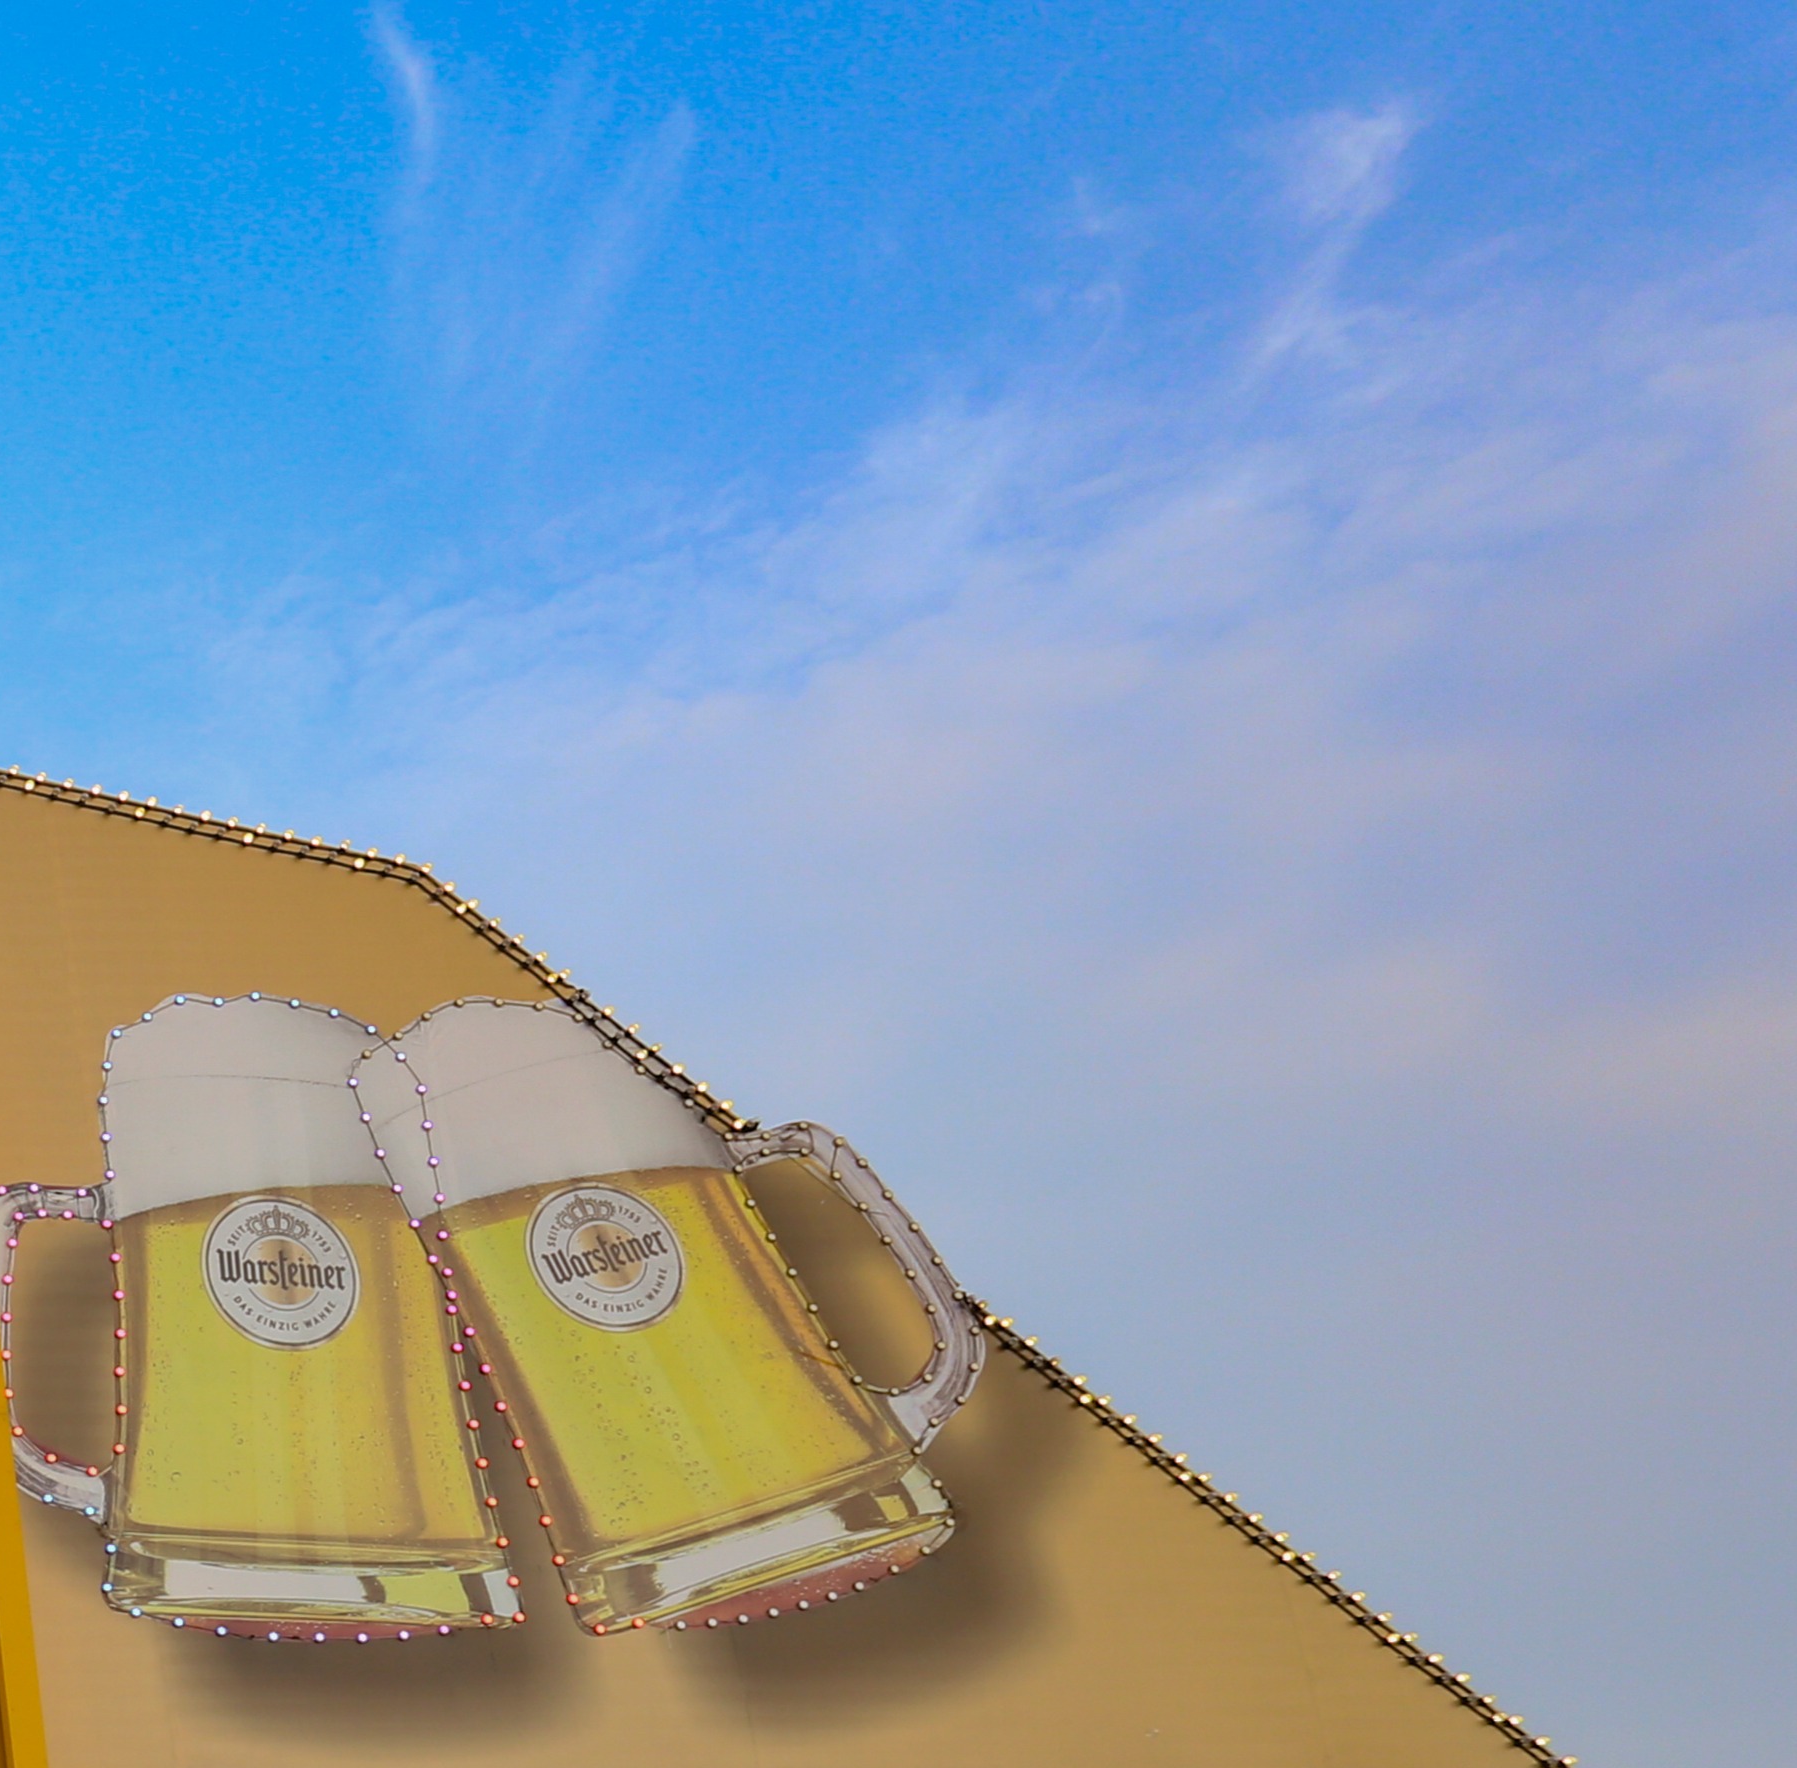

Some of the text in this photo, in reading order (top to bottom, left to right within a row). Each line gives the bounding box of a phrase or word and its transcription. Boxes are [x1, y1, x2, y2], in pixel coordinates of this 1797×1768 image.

[227, 1225, 332, 1253] SEIT 1753
[541, 1230, 668, 1284] Warsteiner
[216, 1248, 346, 1290] Warsteiner
[233, 1295, 336, 1331] DAS EINZIG WAHRE
[575, 1292, 598, 1308] DAS
[603, 1301, 645, 1313] EINZIG
